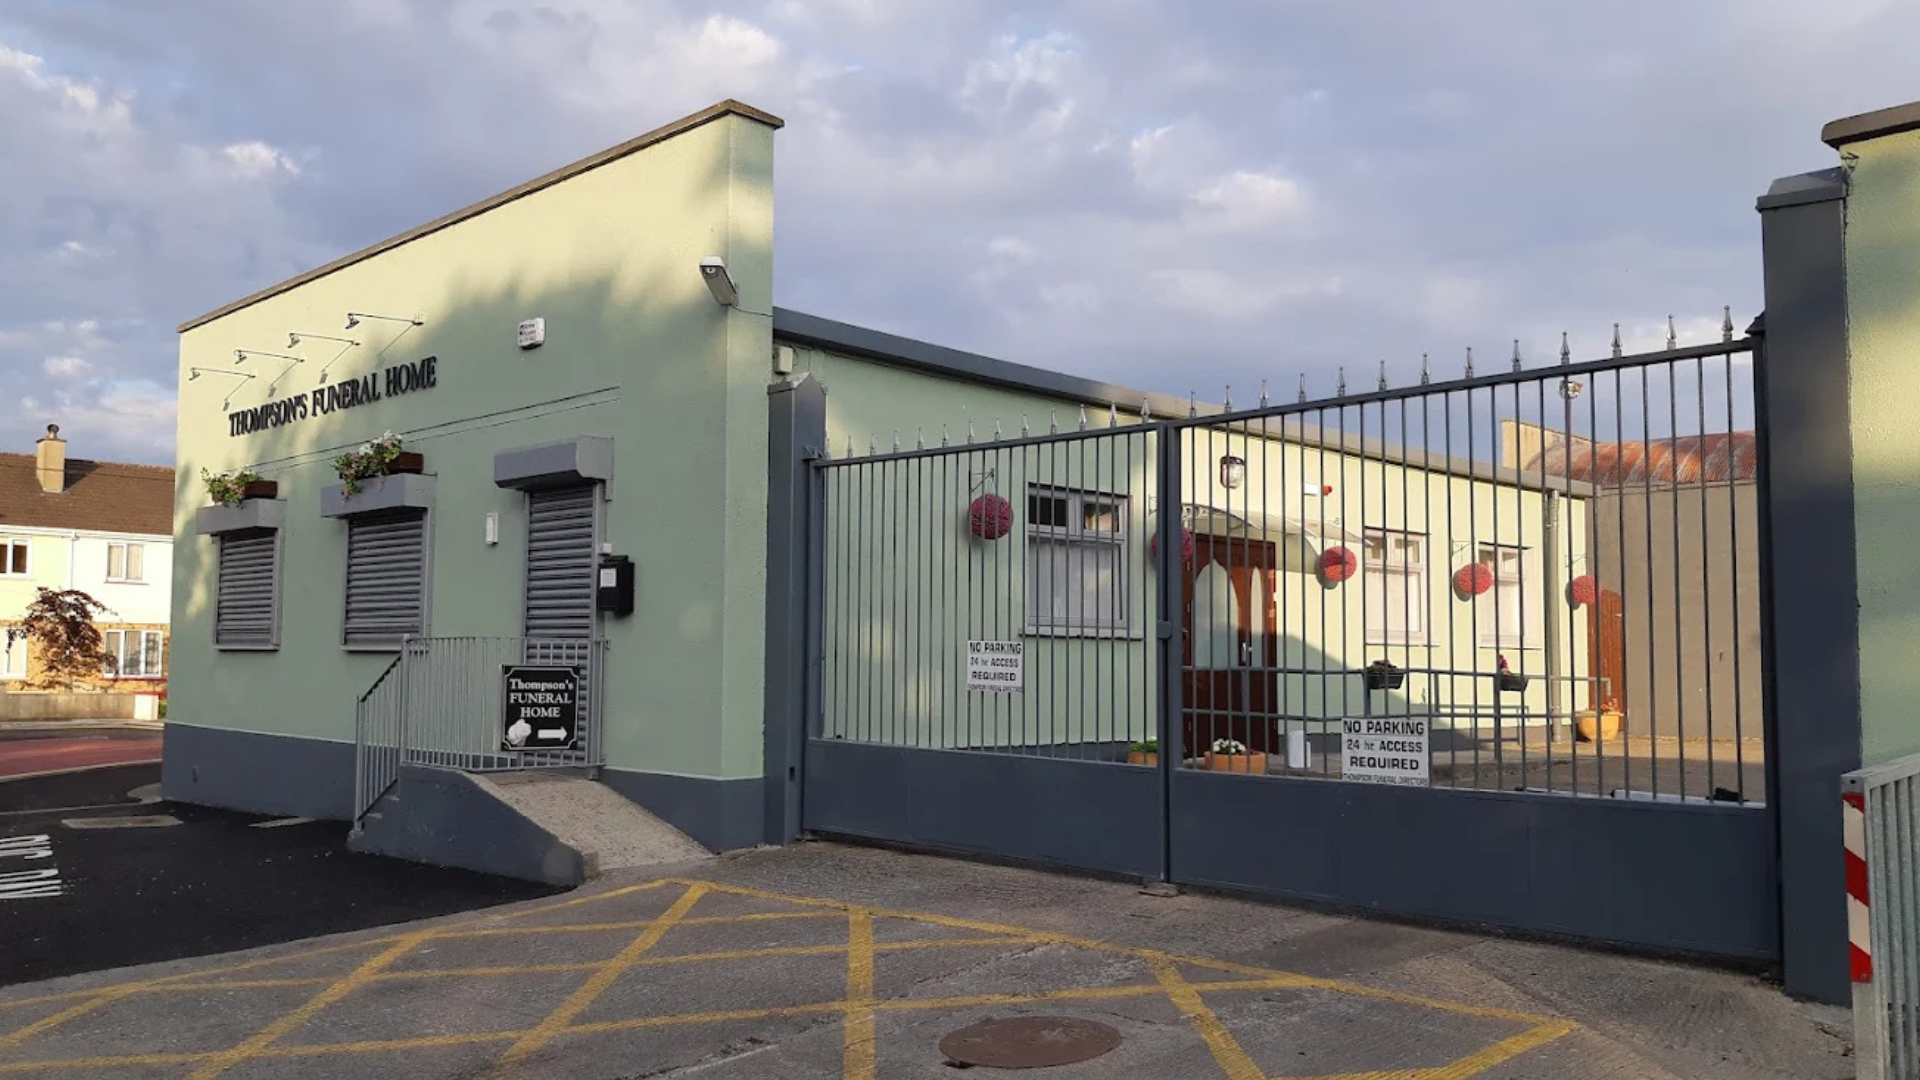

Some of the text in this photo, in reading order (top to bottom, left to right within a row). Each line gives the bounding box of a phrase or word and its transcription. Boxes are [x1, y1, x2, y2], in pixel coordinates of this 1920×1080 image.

[228, 356, 437, 437] THOMPSON'S FUNERAL HOME
[970, 641, 1021, 654] NO PARKING
[990, 657, 1019, 668] ACCESS
[972, 671, 1016, 682] REQUIRED
[509, 678, 574, 692] Thompson's
[509, 692, 573, 704] FUNERAL
[520, 706, 561, 718] HOME
[1343, 720, 1425, 735] NO PARKING
[1346, 738, 1423, 753] 24 hr ACCESS
[1349, 756, 1419, 770] REQUIRED
